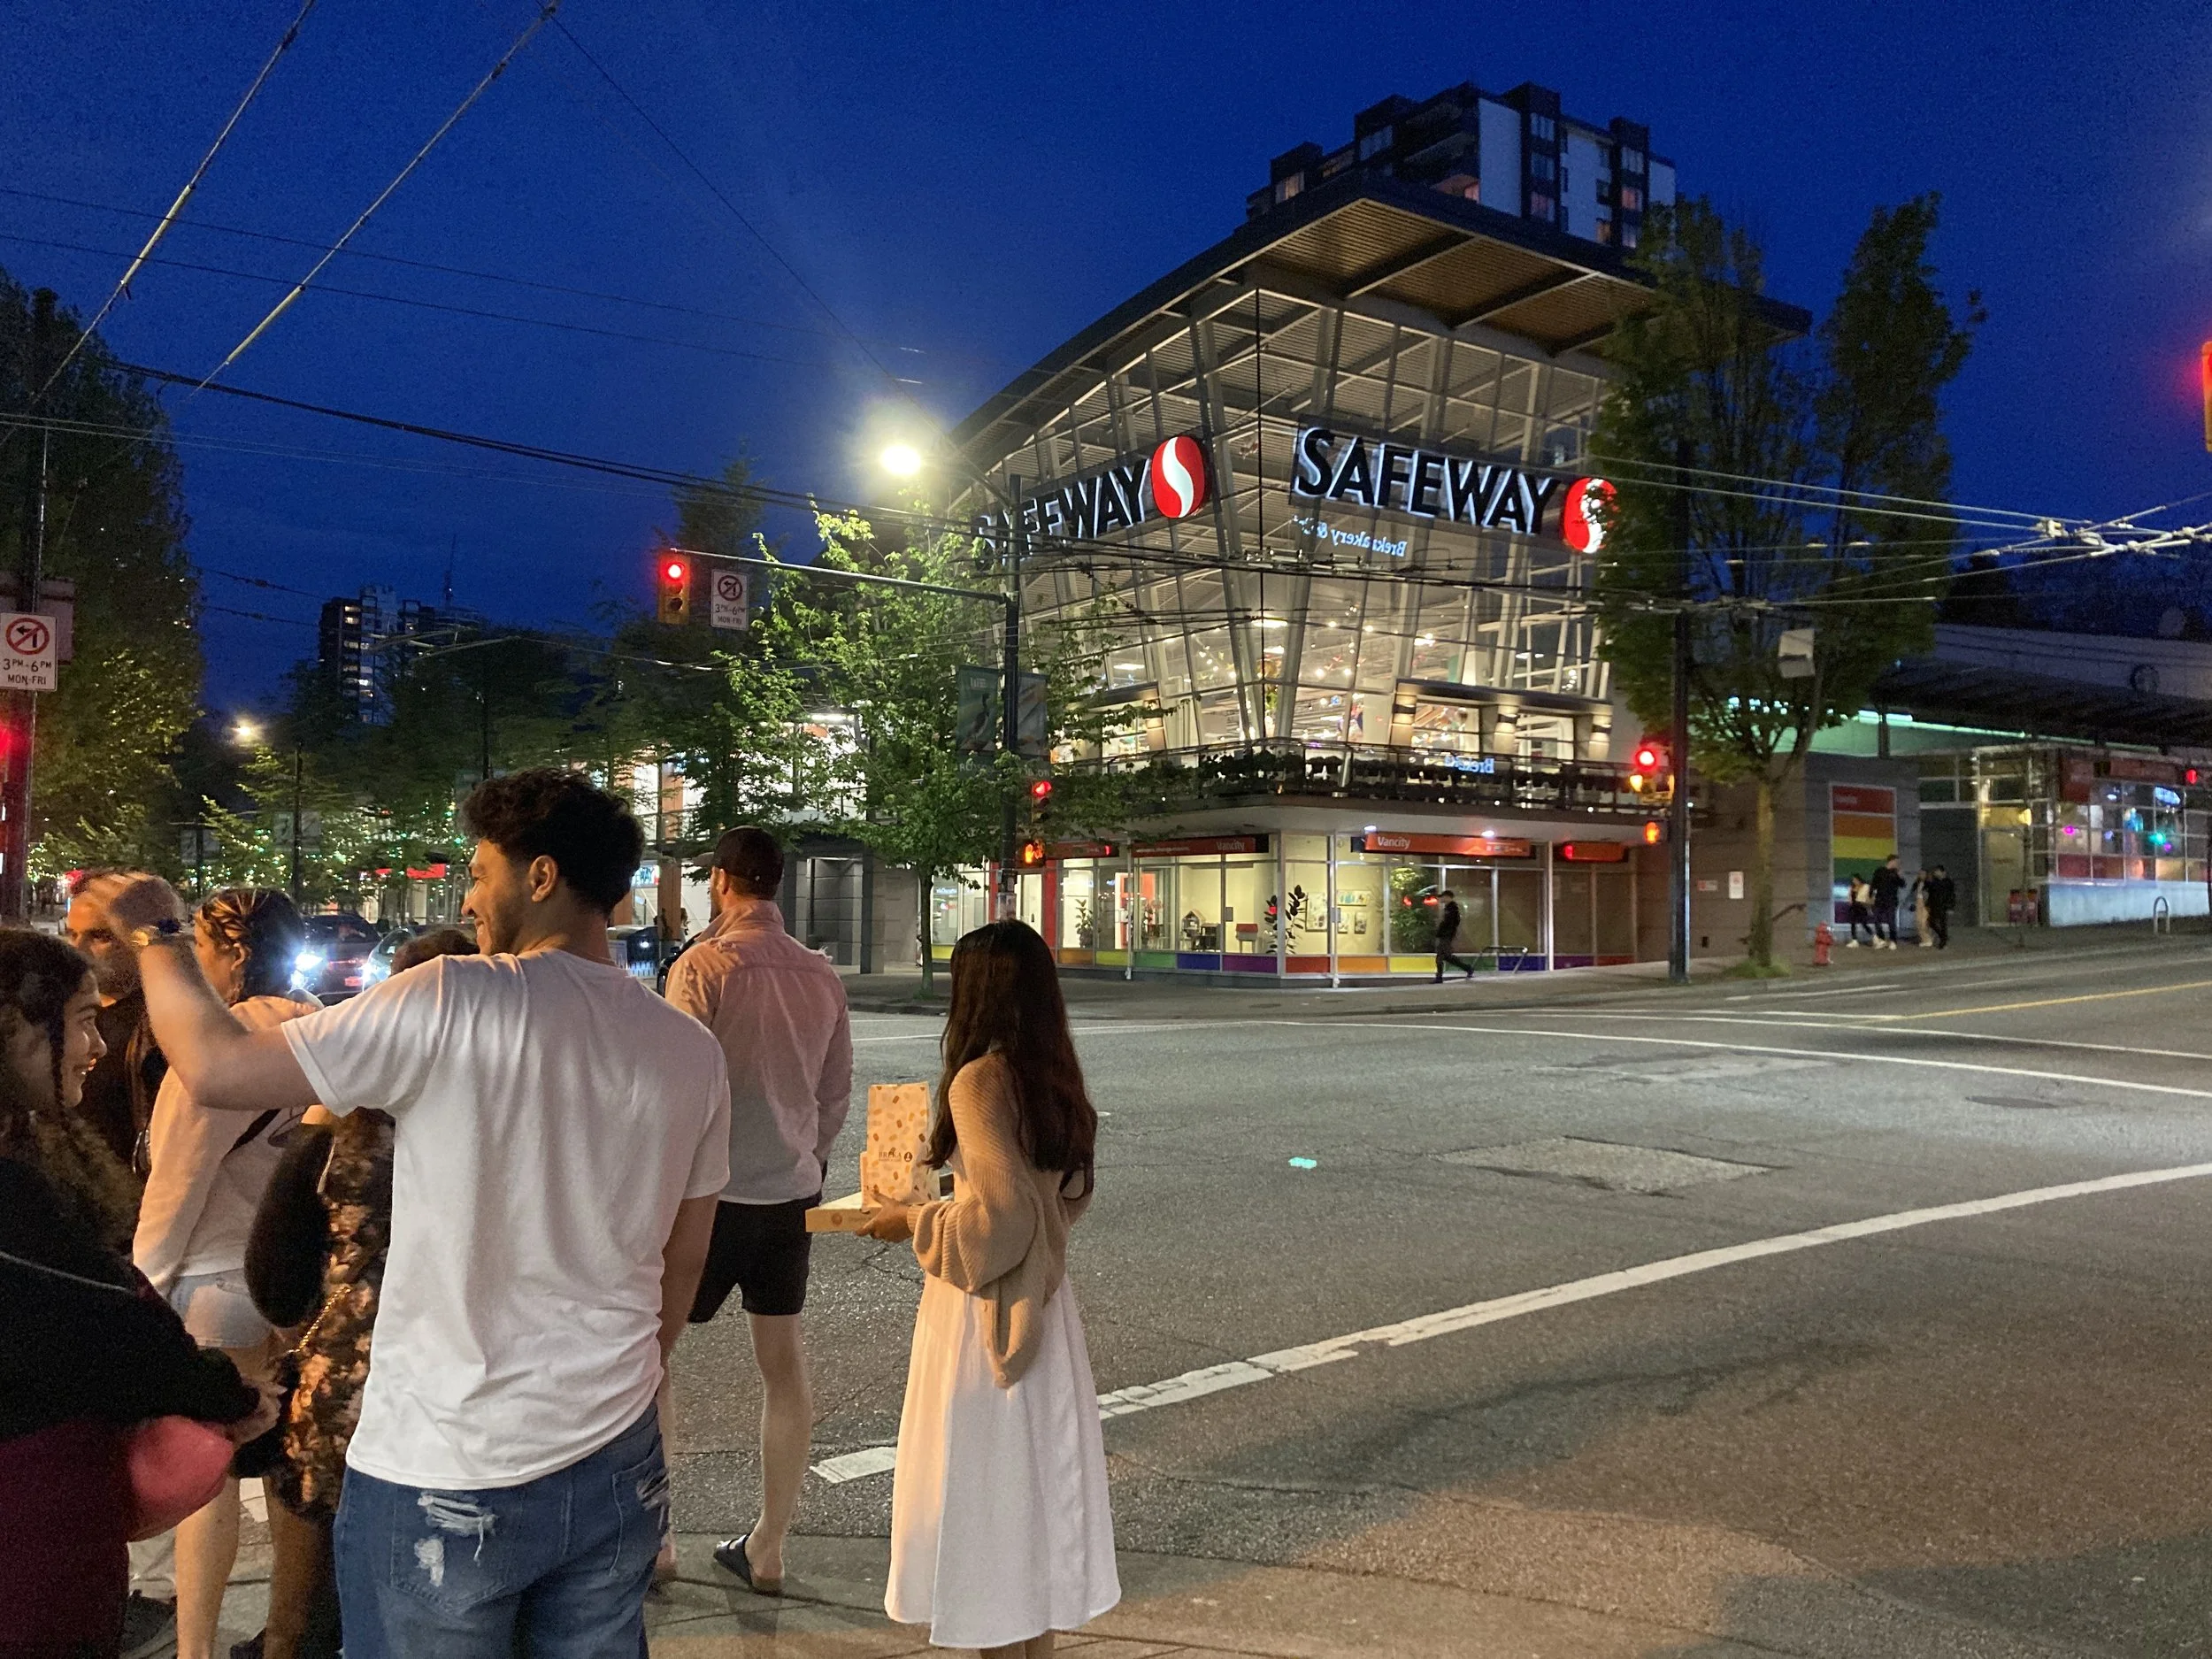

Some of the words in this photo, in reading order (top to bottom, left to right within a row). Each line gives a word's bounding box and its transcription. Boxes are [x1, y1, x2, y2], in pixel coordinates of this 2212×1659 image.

[1293, 426, 1560, 535] SAFEWAY
[1216, 841, 1246, 851] Vancity
[1377, 836, 1410, 850] Vancity
